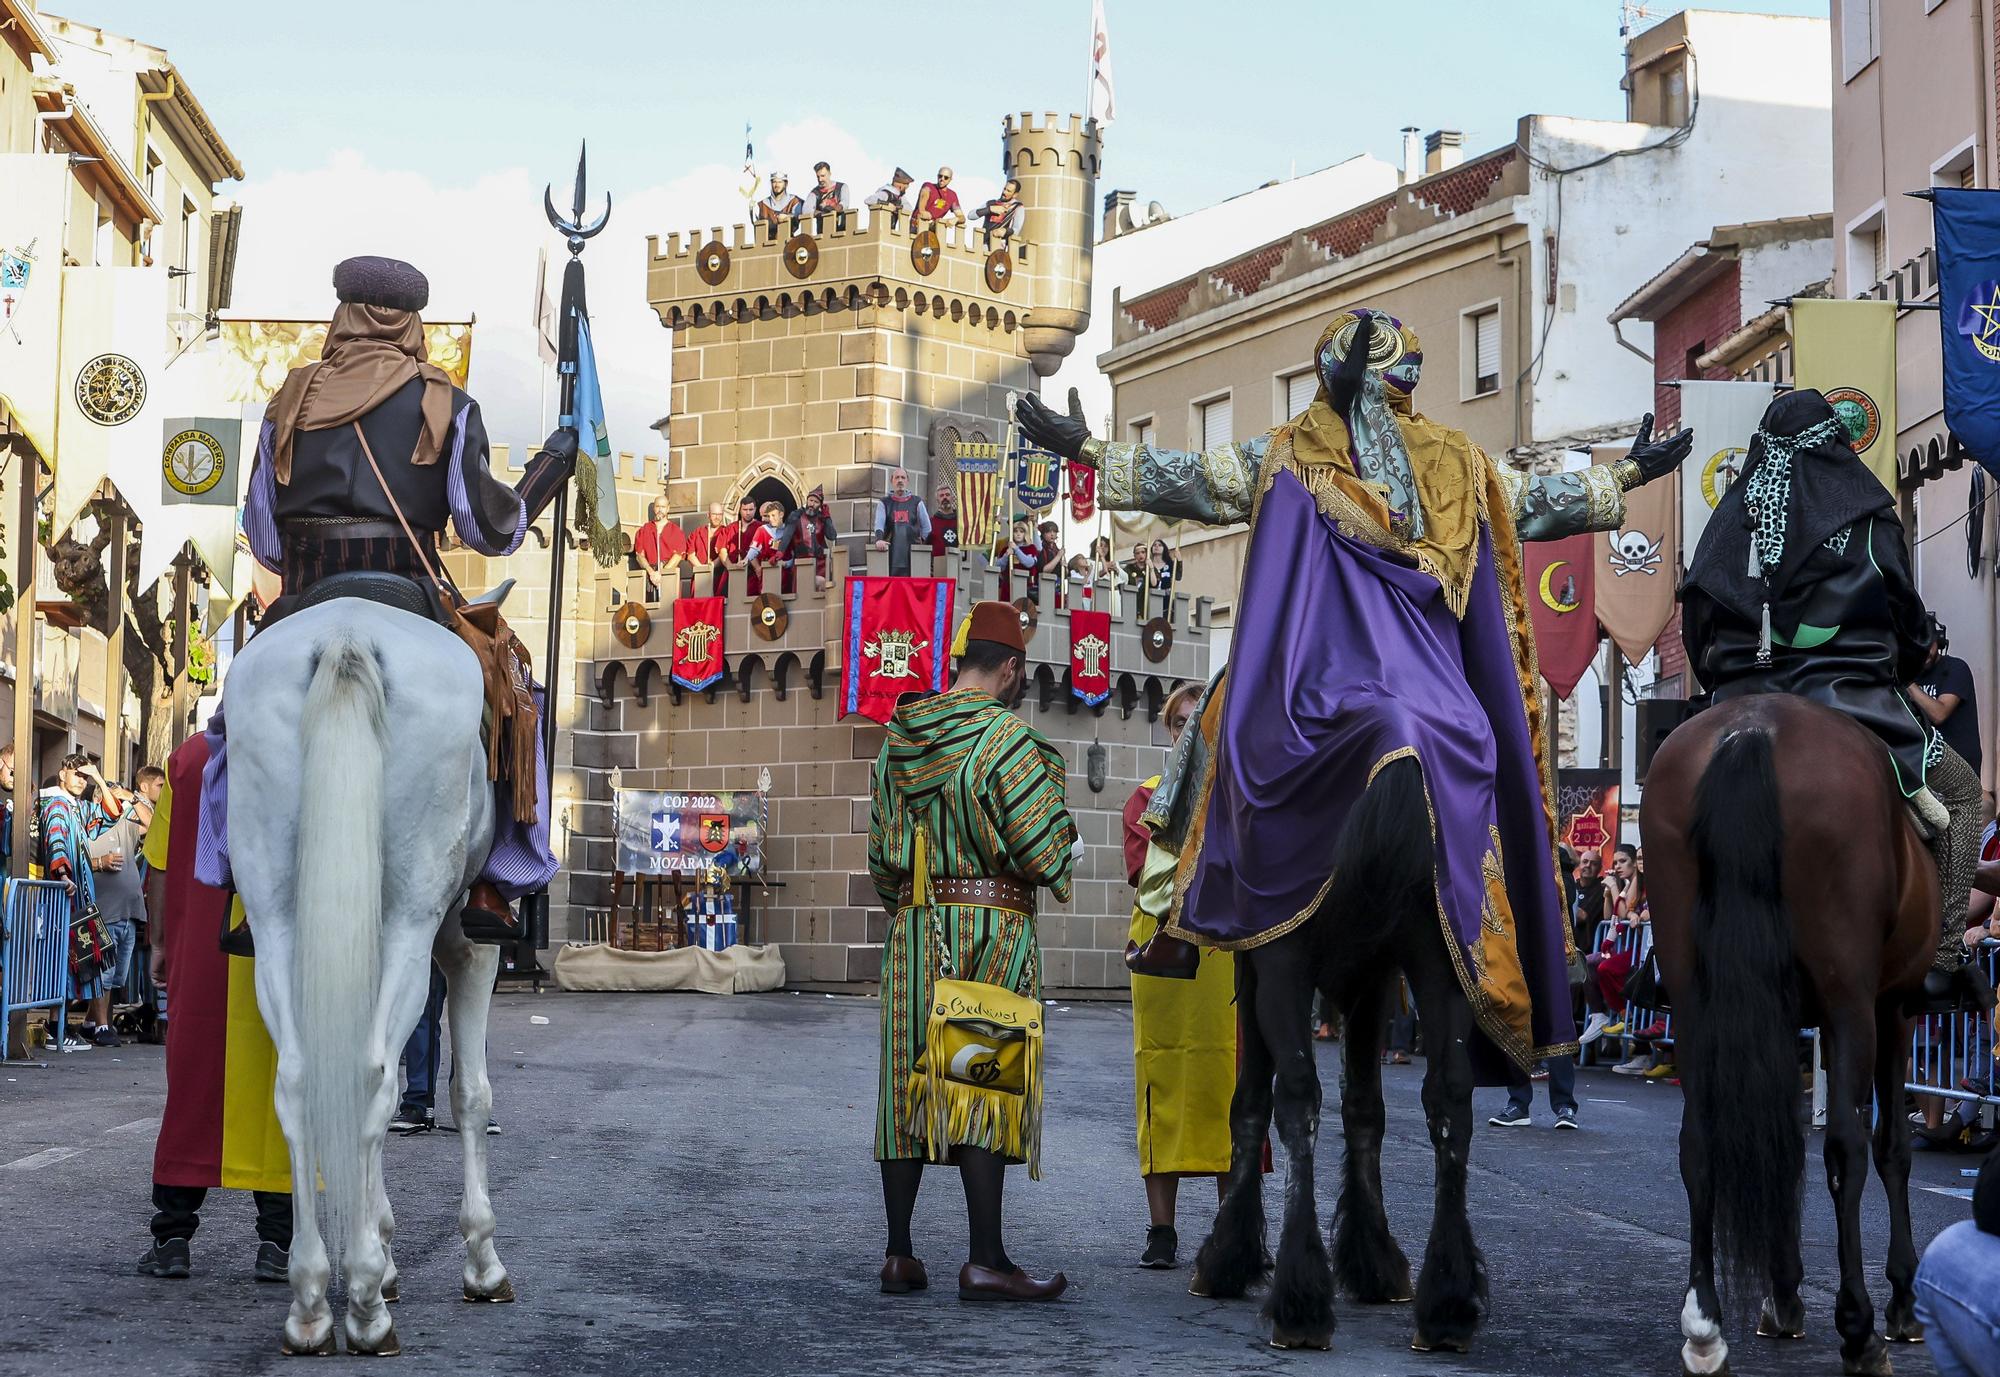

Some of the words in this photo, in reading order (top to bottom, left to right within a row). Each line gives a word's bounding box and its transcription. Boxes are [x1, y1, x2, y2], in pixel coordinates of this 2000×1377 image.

[164, 432, 196, 468] COMPARSA
[198, 434, 223, 471] MASEROS
[663, 796, 689, 808] COP
[691, 796, 716, 808] 2022
